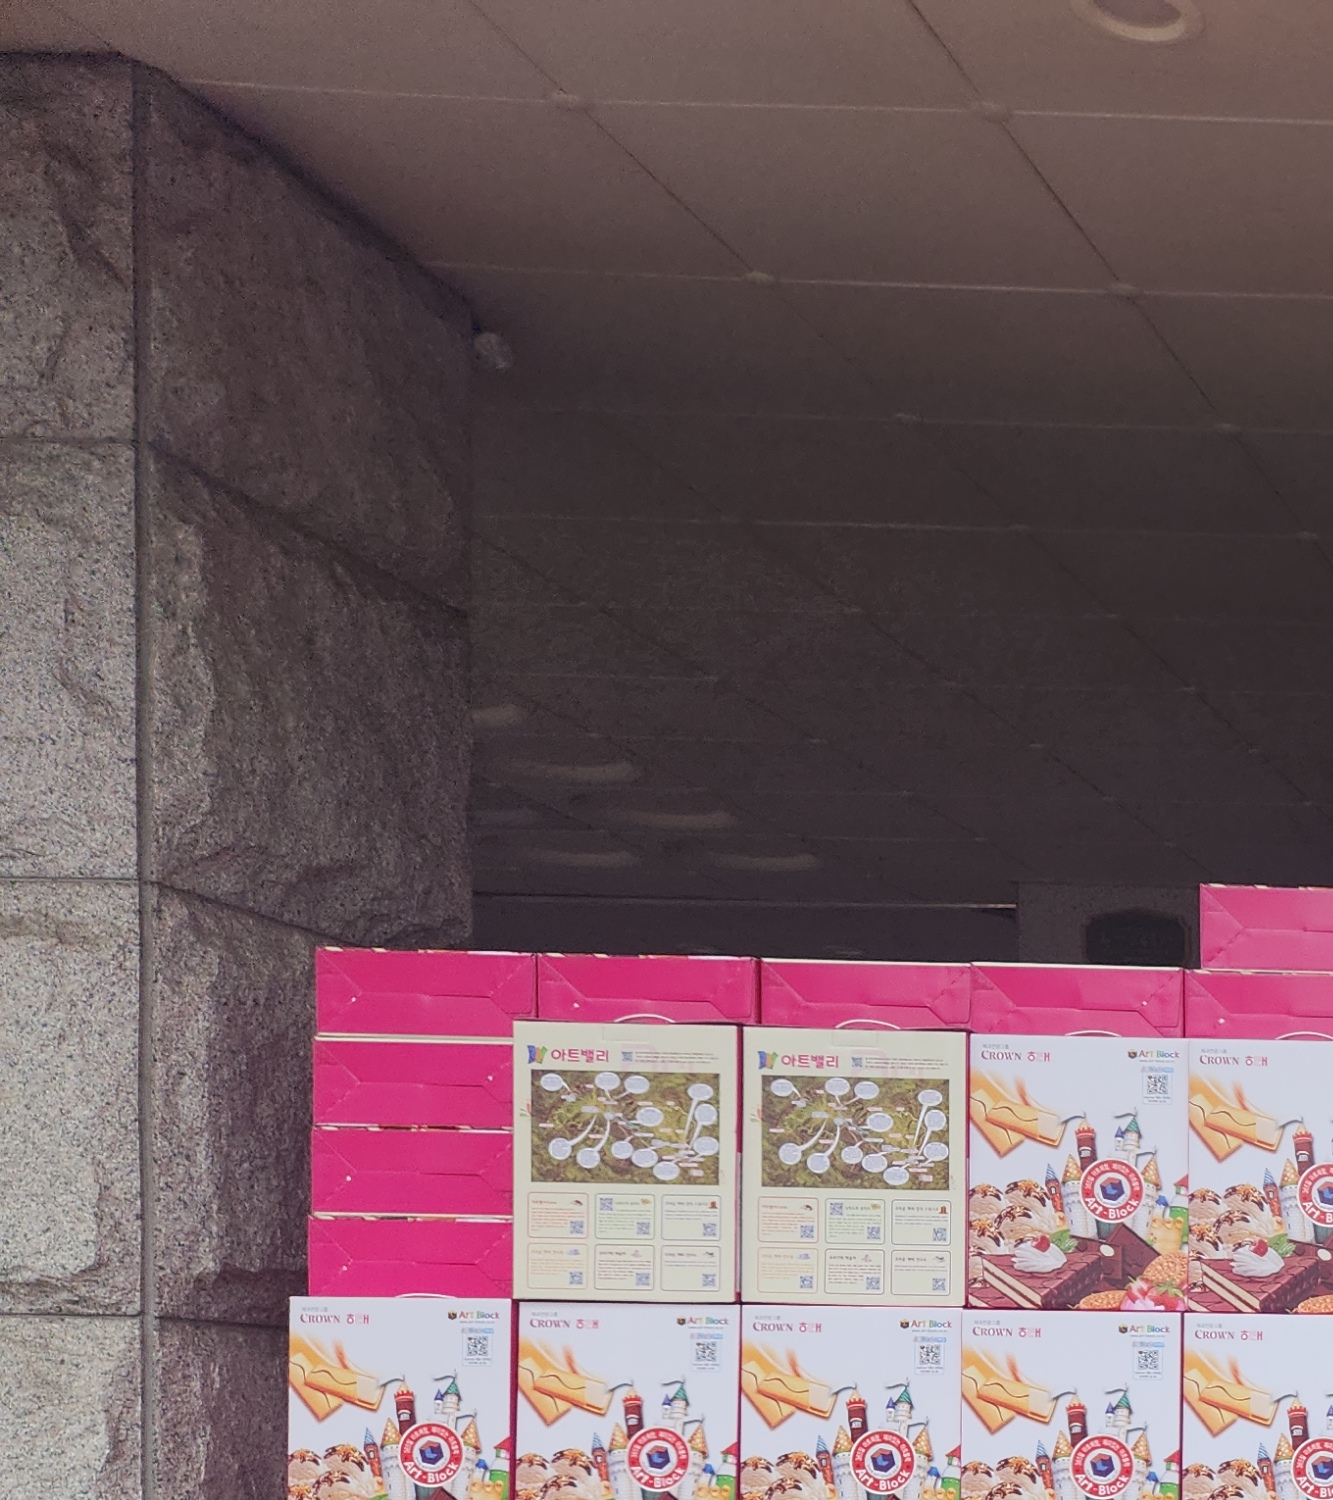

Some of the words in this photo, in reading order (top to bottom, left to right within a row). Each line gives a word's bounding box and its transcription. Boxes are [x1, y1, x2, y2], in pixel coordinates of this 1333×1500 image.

[551, 1048, 609, 1064] 아트밸리
[980, 1050, 1021, 1060] CROWN
[1138, 1049, 1153, 1057] Art
[1156, 1050, 1180, 1058] Block
[780, 1053, 840, 1070] 아트밸리
[1199, 1054, 1239, 1064] CROWN
[299, 1313, 340, 1323] CROWN
[458, 1310, 474, 1318] Art
[476, 1310, 500, 1318] Block
[752, 1321, 793, 1331] CROWN
[910, 1319, 926, 1327] Art
[928, 1319, 952, 1327] Block
[972, 1326, 1012, 1336] CROWN
[1194, 1329, 1234, 1339] CROWN
